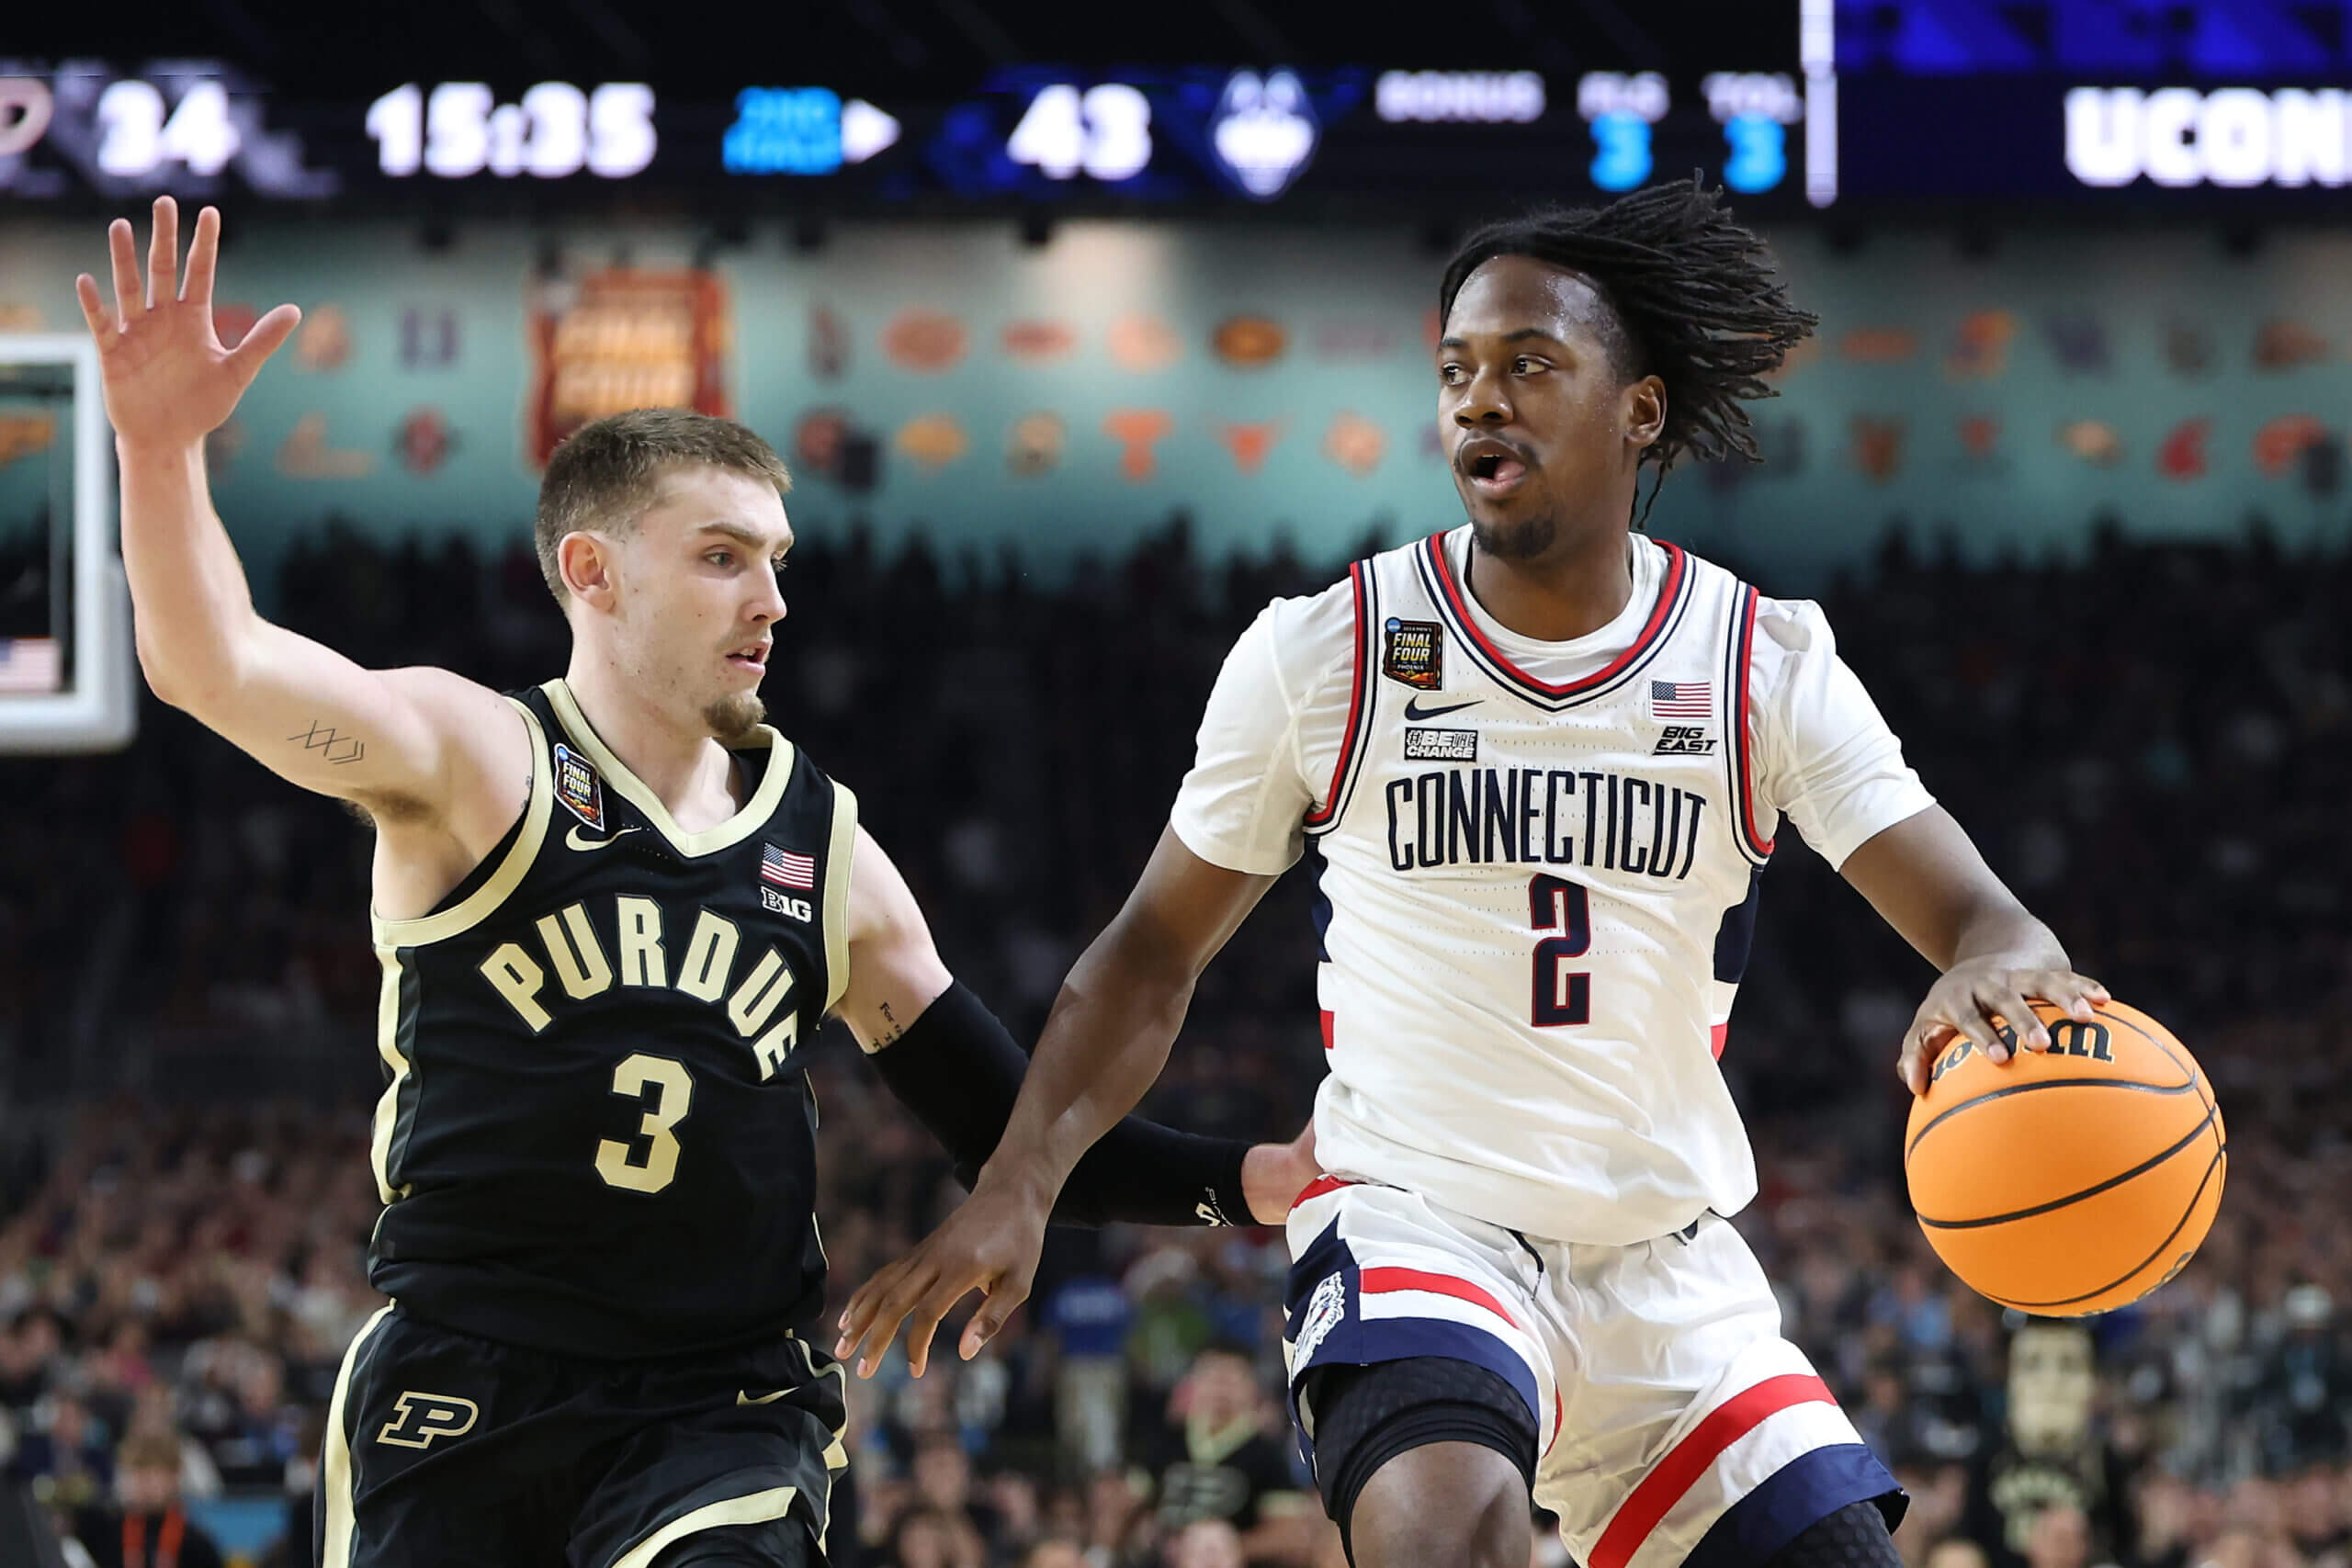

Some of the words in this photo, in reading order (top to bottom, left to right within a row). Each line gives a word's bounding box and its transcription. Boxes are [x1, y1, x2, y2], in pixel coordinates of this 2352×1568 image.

[97, 79, 239, 176] 34
[366, 81, 658, 177] 15:35
[1007, 83, 1152, 180] 43
[1589, 109, 1653, 192] 3
[1724, 110, 1787, 193] 3
[1392, 647, 1430, 661] FOUR
[1393, 632, 1431, 648] FINAL
[563, 761, 592, 786] FINAL
[1406, 746, 1475, 759] CHANGE
[1655, 739, 1718, 751] EAST
[1661, 726, 1705, 739] BIG
[562, 773, 592, 797] FOUR
[1385, 768, 1707, 881] CONNECTICUT
[478, 896, 798, 1083] PURDUE
[1528, 872, 1591, 1027] 2
[594, 1052, 694, 1194] 3
[376, 1390, 480, 1450] P
